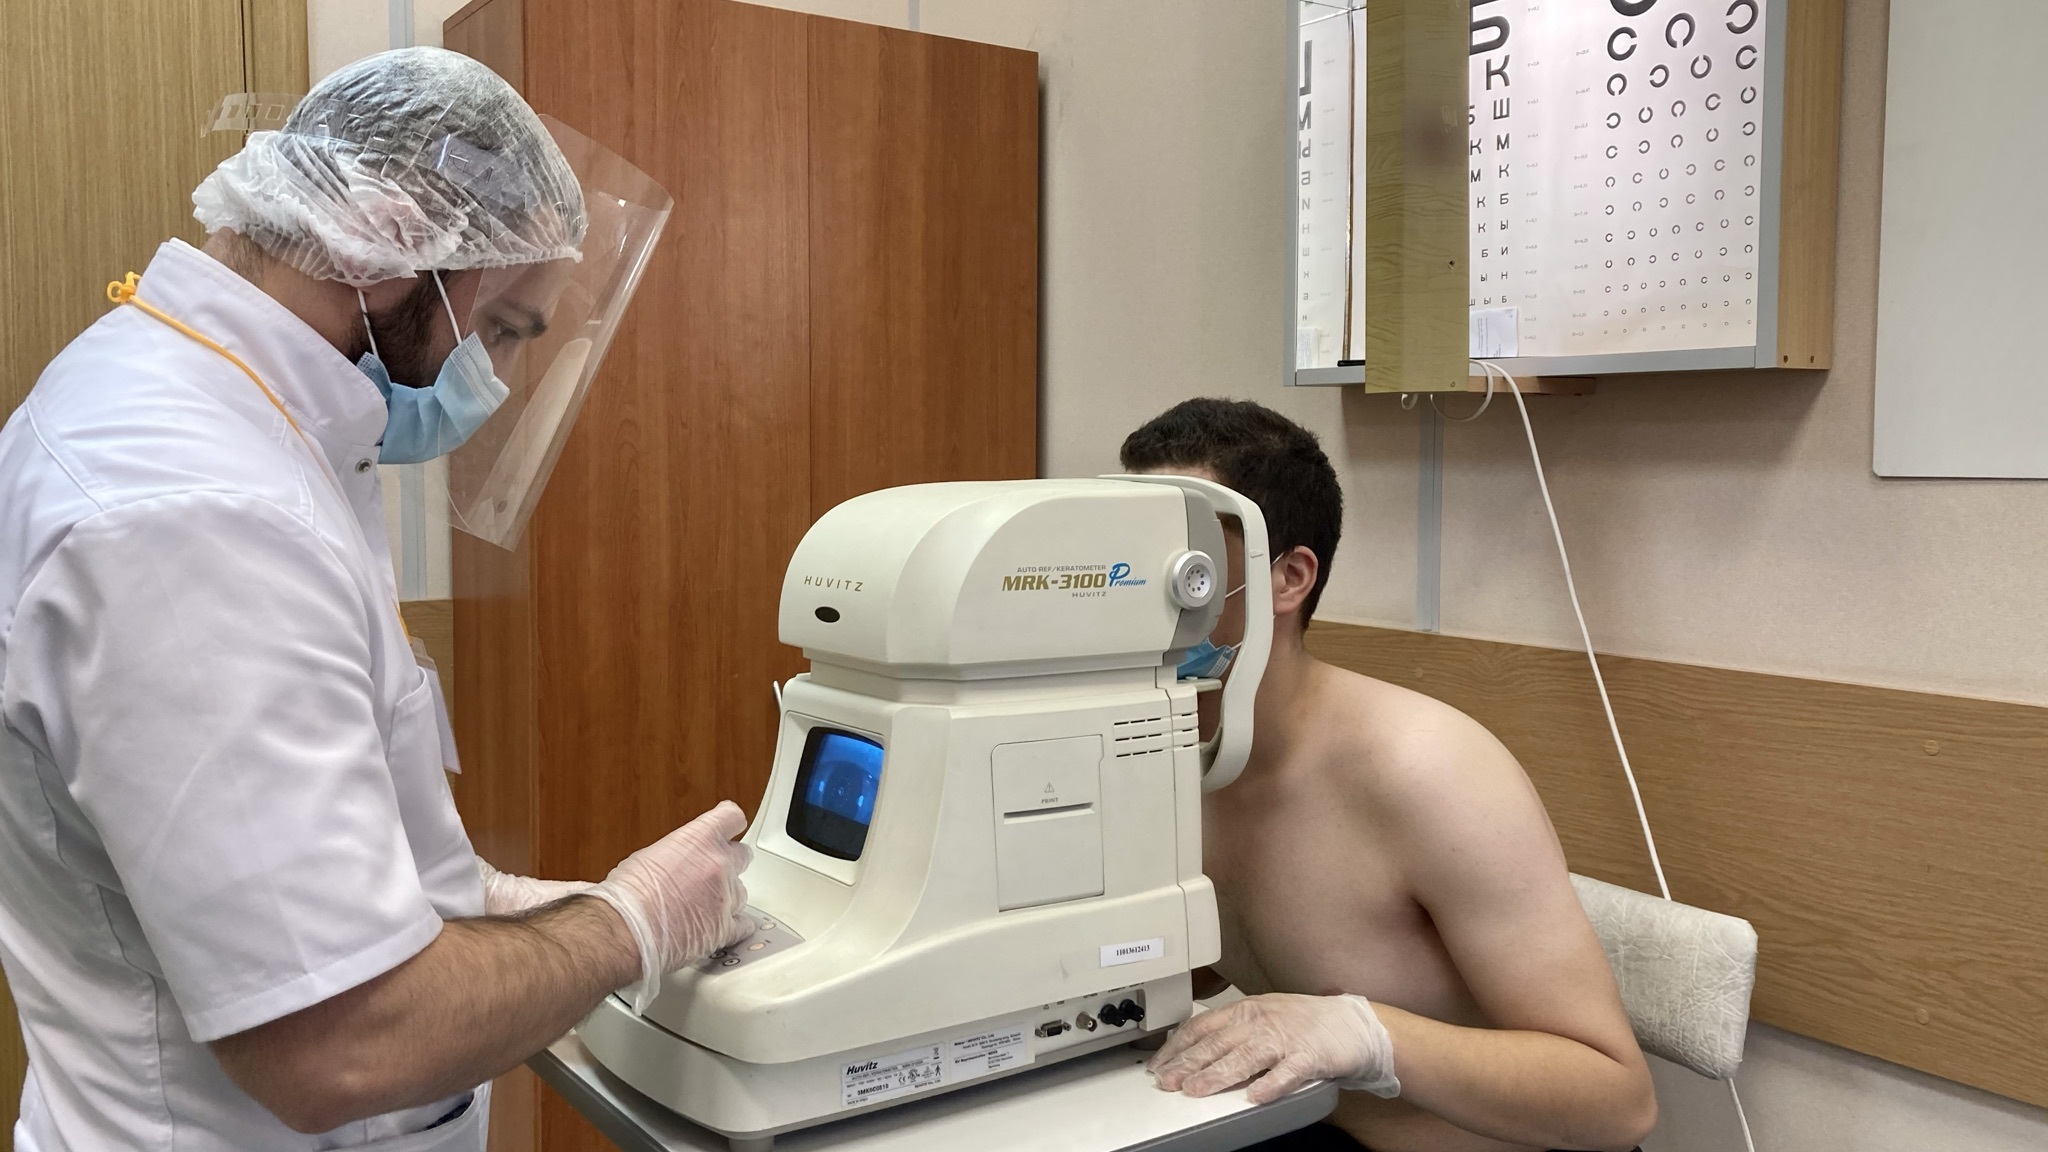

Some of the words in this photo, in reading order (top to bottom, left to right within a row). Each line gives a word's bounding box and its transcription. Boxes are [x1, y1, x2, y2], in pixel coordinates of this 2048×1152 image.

[1486, 54, 1510, 90] К
[1494, 97, 1510, 120] Ш
[1470, 138, 1482, 155] К
[1497, 133, 1510, 150] М
[1471, 168, 1481, 182] М
[1499, 163, 1510, 178] К
[1477, 196, 1486, 208] К
[1500, 192, 1509, 204] Б
[1478, 222, 1486, 233] К
[1501, 219, 1509, 230] Ы
[1482, 248, 1489, 257] Б
[1502, 246, 1509, 255] И
[1481, 273, 1488, 281] Ы
[1501, 271, 1508, 279] Н
[1502, 295, 1508, 303] Б
[1038, 564, 1106, 573] REF/KERATOMETER
[804, 575, 863, 592] HUVITZ
[1002, 573, 1107, 591] MRK-3100
[1109, 563, 1147, 587] Premium
[847, 1061, 878, 1075] Huvitz
